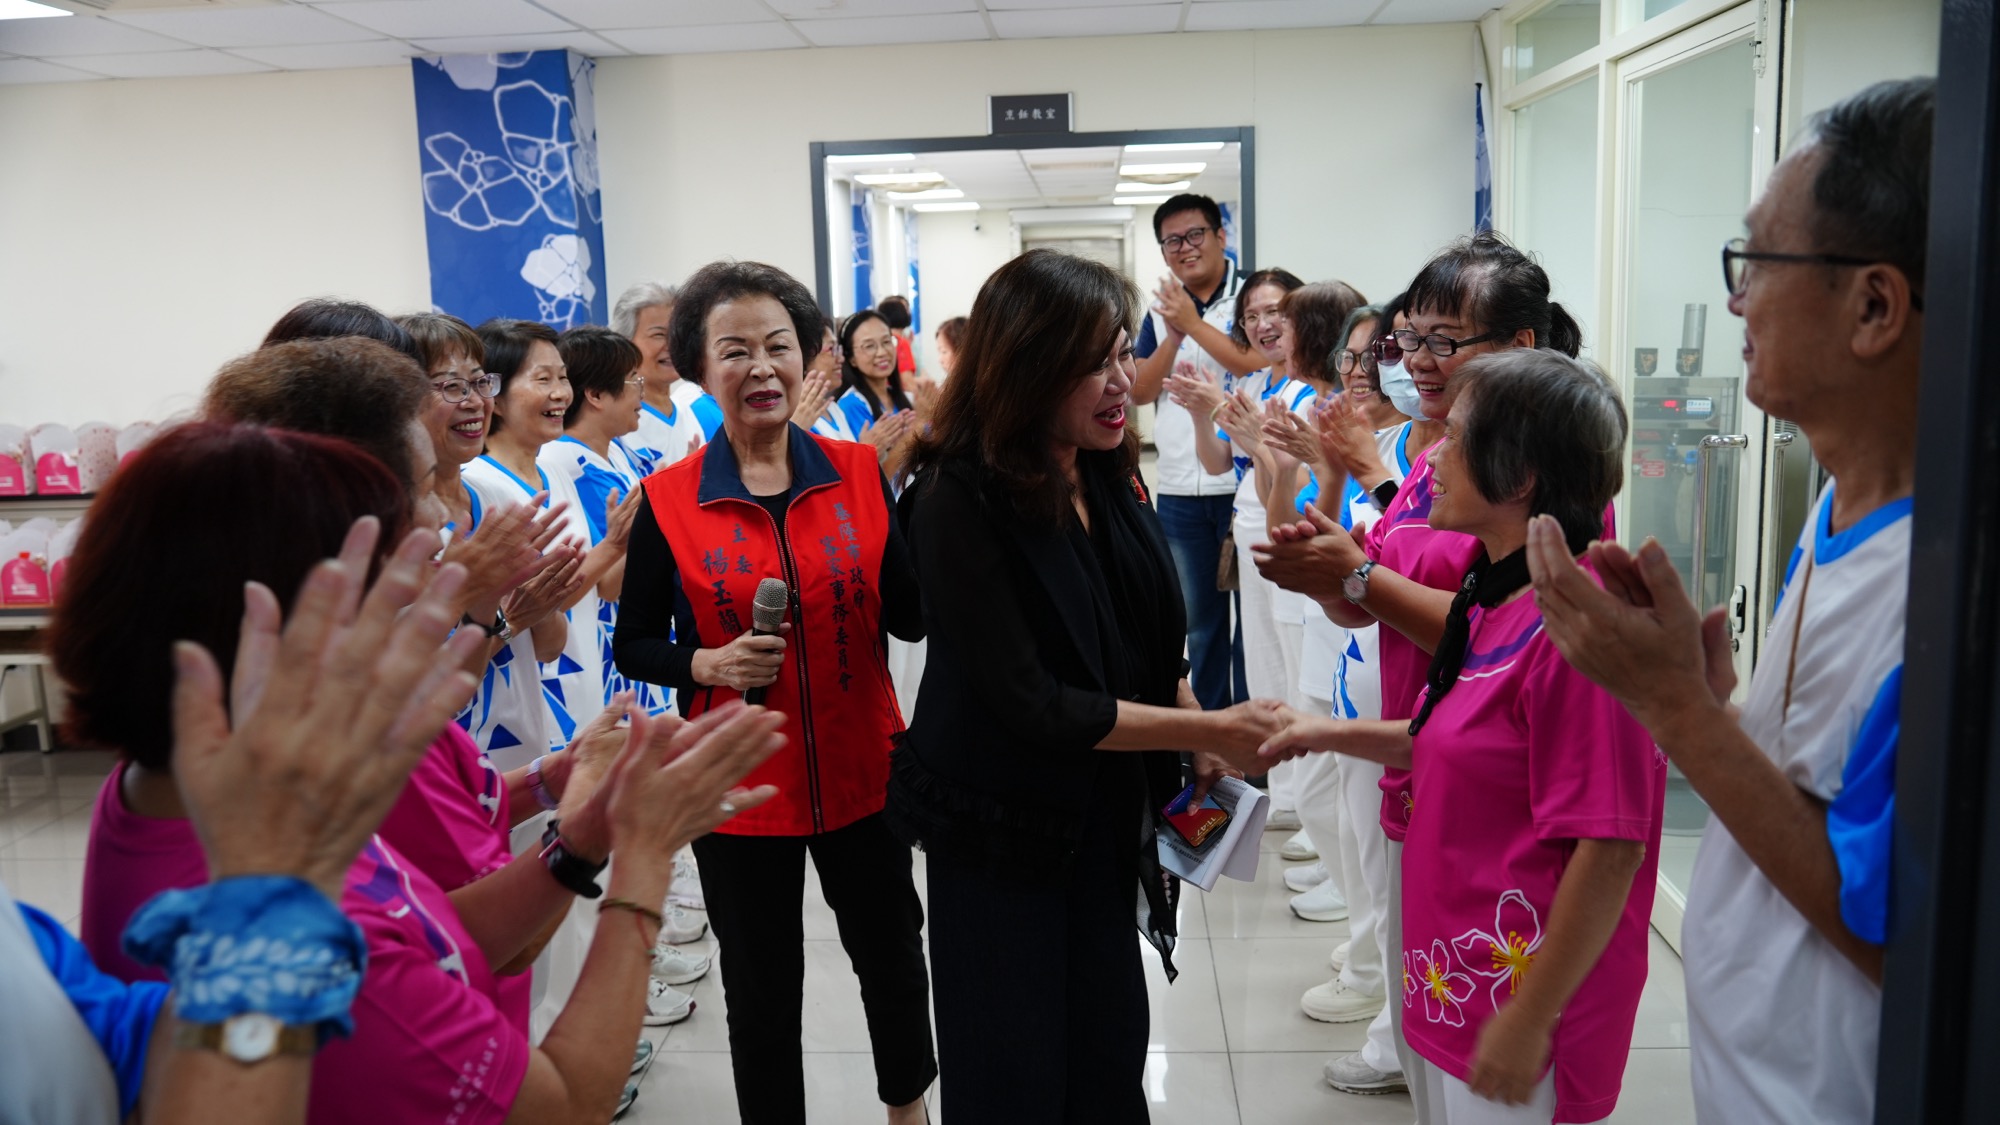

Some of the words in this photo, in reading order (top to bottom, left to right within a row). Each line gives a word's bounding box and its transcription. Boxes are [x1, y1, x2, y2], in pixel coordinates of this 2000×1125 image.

[702, 547, 743, 635] 楊玉蘭
[732, 523, 753, 575] 主委
[833, 502, 867, 609] 基隆市政府
[819, 535, 854, 693] 客家事務委員會
[1197, 817, 1217, 836] 11:47
